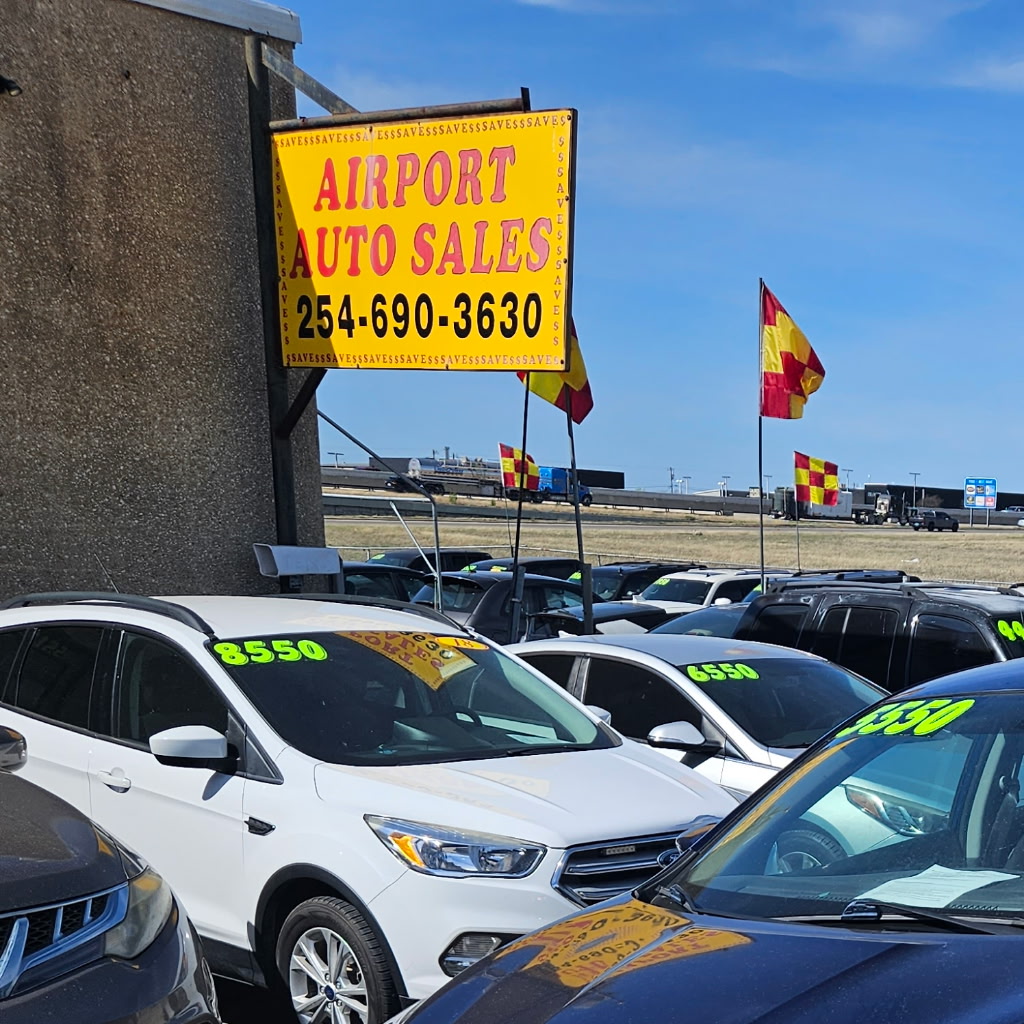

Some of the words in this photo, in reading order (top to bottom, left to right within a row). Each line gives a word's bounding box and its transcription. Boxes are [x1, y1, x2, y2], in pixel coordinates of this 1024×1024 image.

[313, 145, 516, 212] AIRPORT
[289, 224, 397, 279] AUTO
[410, 217, 553, 276] SALES
[296, 292, 542, 339] 254-690-3630
[213, 639, 328, 666] 8550
[687, 663, 760, 683] 6550
